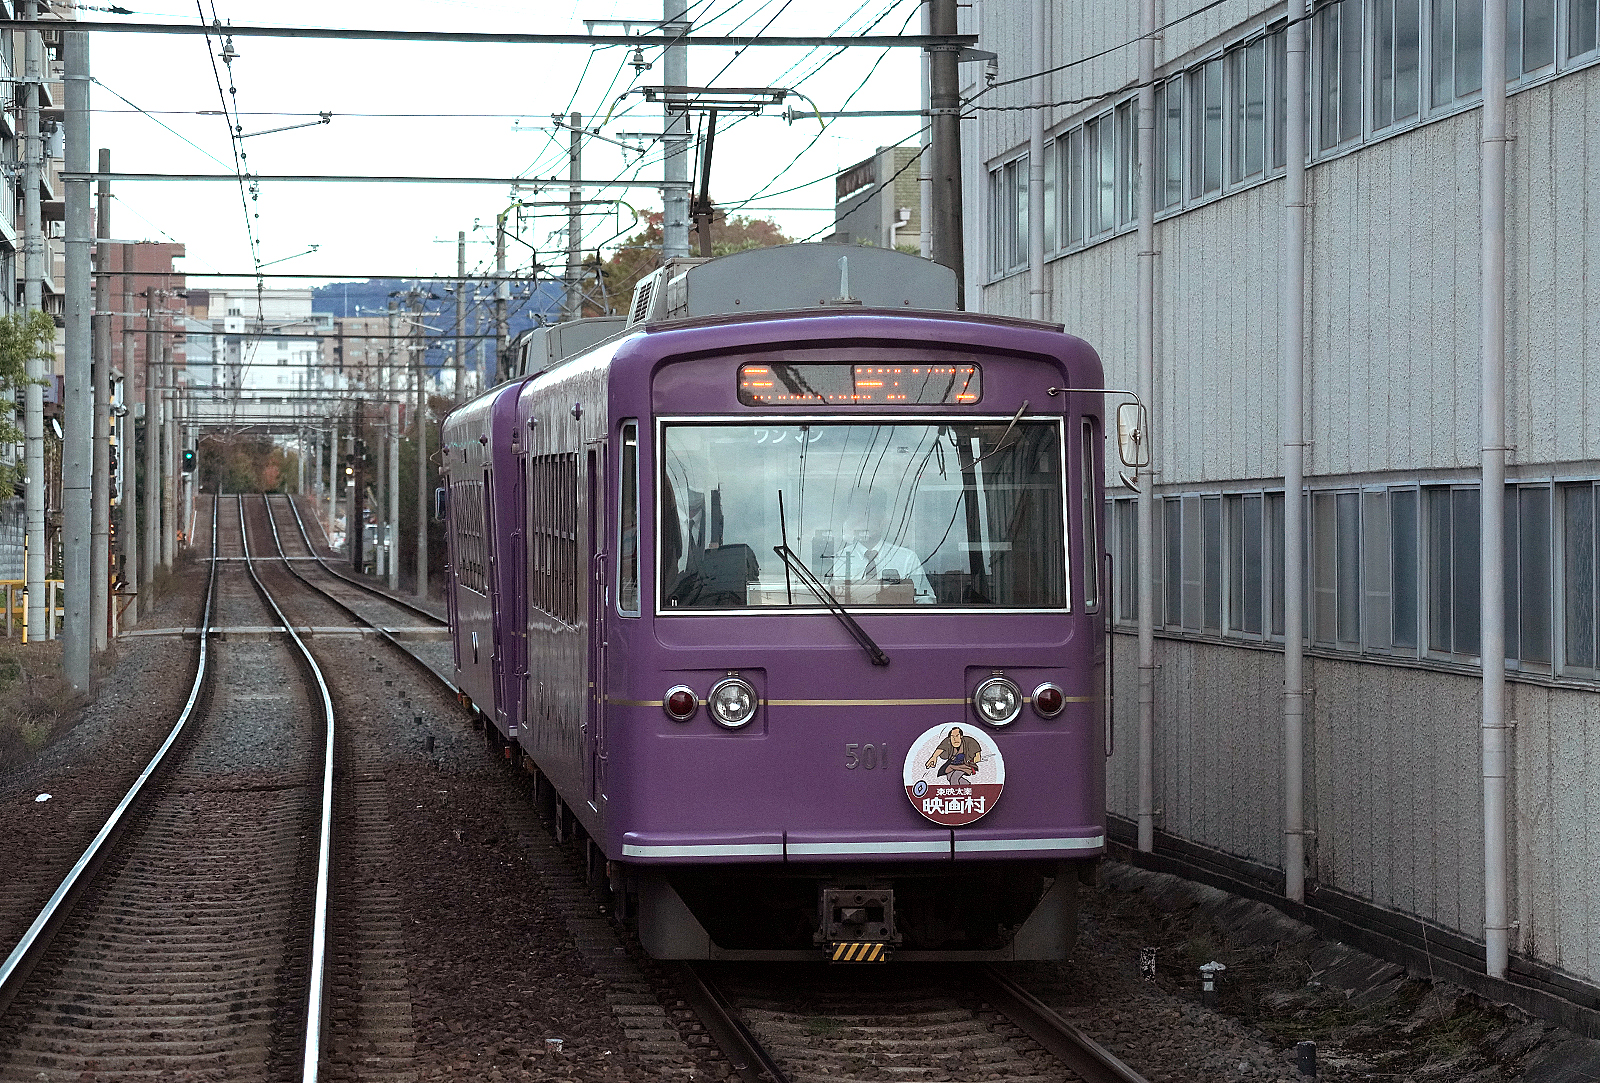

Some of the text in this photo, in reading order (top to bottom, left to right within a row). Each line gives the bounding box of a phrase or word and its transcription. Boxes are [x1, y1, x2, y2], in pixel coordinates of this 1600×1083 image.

[845, 743, 889, 770] 501
[922, 796, 986, 815] 映画村
